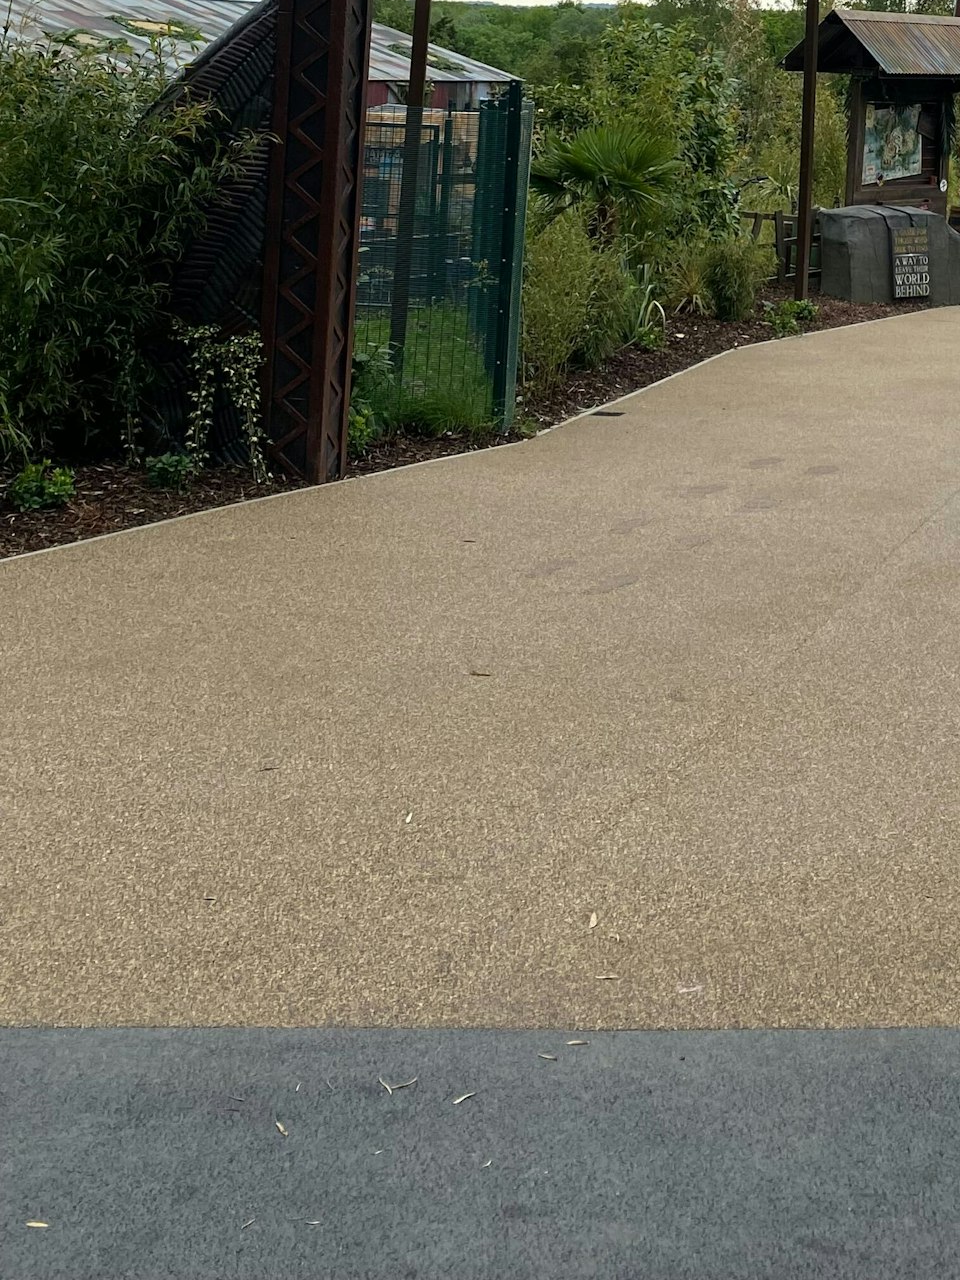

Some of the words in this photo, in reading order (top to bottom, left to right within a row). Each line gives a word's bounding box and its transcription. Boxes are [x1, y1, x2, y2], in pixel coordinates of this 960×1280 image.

[901, 257, 917, 265] WAY
[918, 256, 929, 265] TO
[895, 272, 930, 285] WORLD
[895, 284, 930, 297] BEHIND
